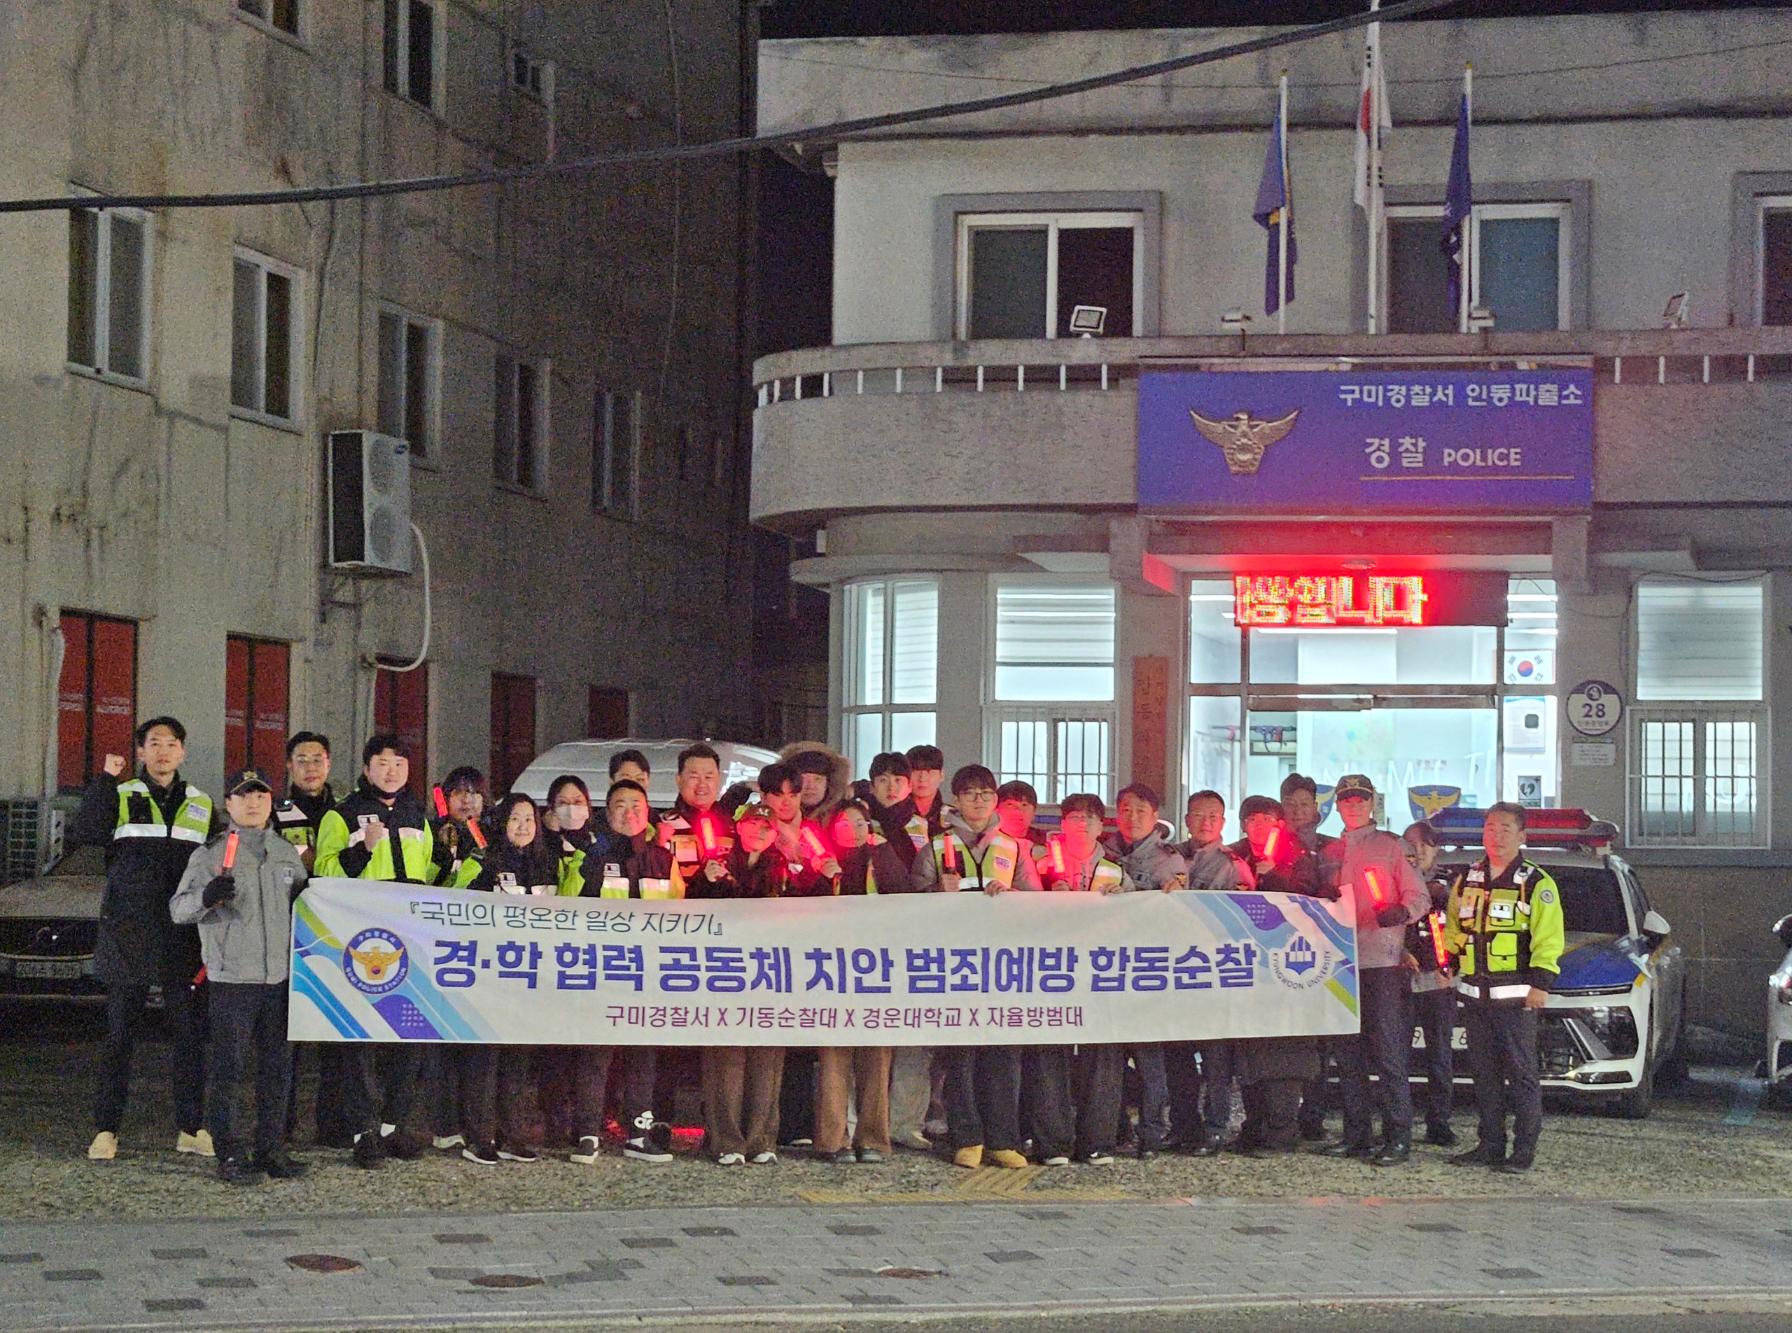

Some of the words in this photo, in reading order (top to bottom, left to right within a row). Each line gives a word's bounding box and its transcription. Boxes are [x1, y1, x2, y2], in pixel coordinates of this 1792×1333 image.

[1338, 384, 1454, 408] 구미경찰서
[1465, 383, 1584, 407] 인동파출소
[1364, 436, 1427, 469] 경찰
[1443, 447, 1522, 467] POLICE
[1581, 702, 1606, 719] 28
[503, 905, 579, 931] 평온한
[585, 910, 635, 933] 일상
[554, 942, 645, 992] 협력
[658, 946, 793, 993] 공동체
[804, 947, 894, 994] 치안
[904, 946, 1079, 994] 범죄예방
[1088, 943, 1257, 992] 합동순찰
[605, 1005, 710, 1028] 구미경찰서
[735, 1006, 838, 1028] 기동순찰대
[862, 1007, 961, 1028] 경운대학교
[986, 1006, 1083, 1028] 자율방범대
